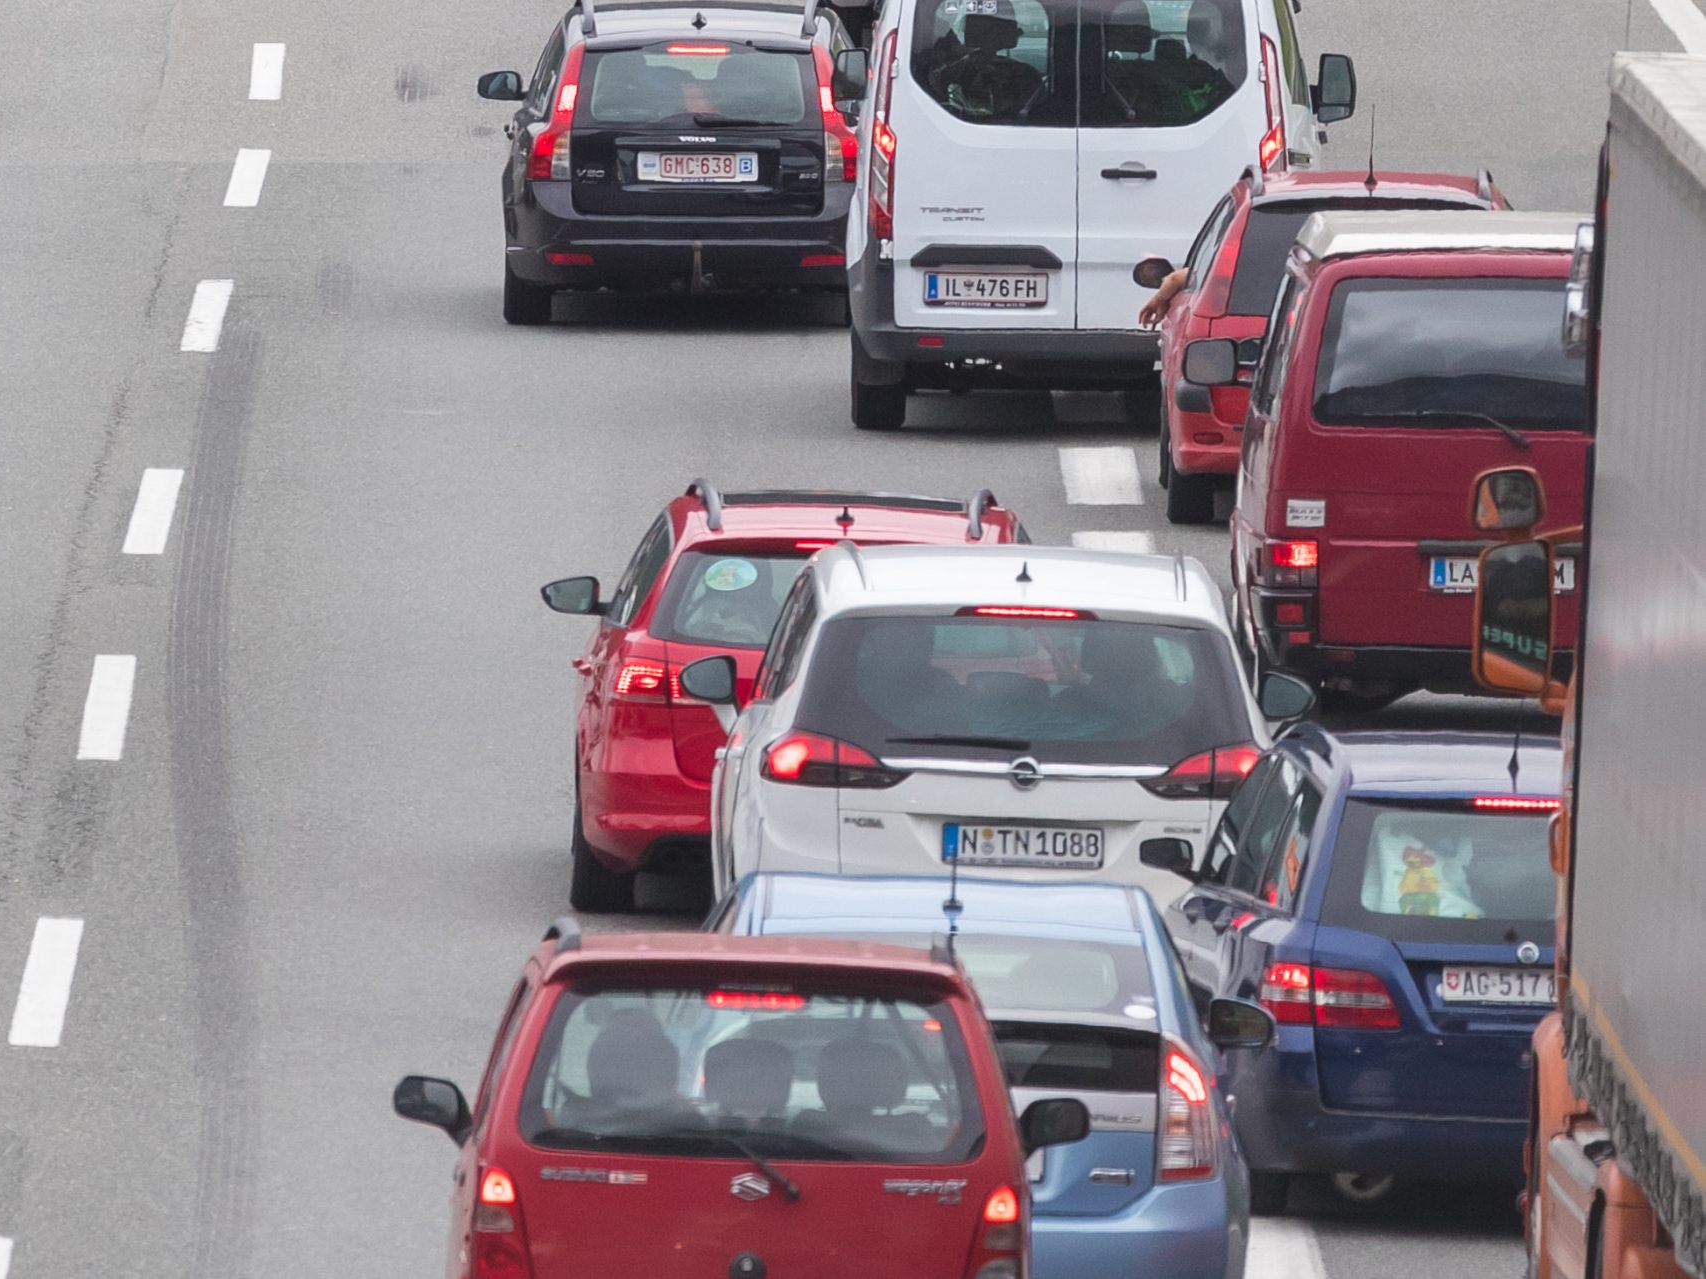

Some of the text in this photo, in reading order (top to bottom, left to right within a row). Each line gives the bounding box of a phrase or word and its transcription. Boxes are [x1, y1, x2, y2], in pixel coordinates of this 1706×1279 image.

[976, 279, 1010, 297] 476
[1014, 279, 1037, 298] FH
[1448, 562, 1475, 583] LA
[961, 828, 1099, 857] N TN 1088
[1463, 971, 1490, 996] AG
